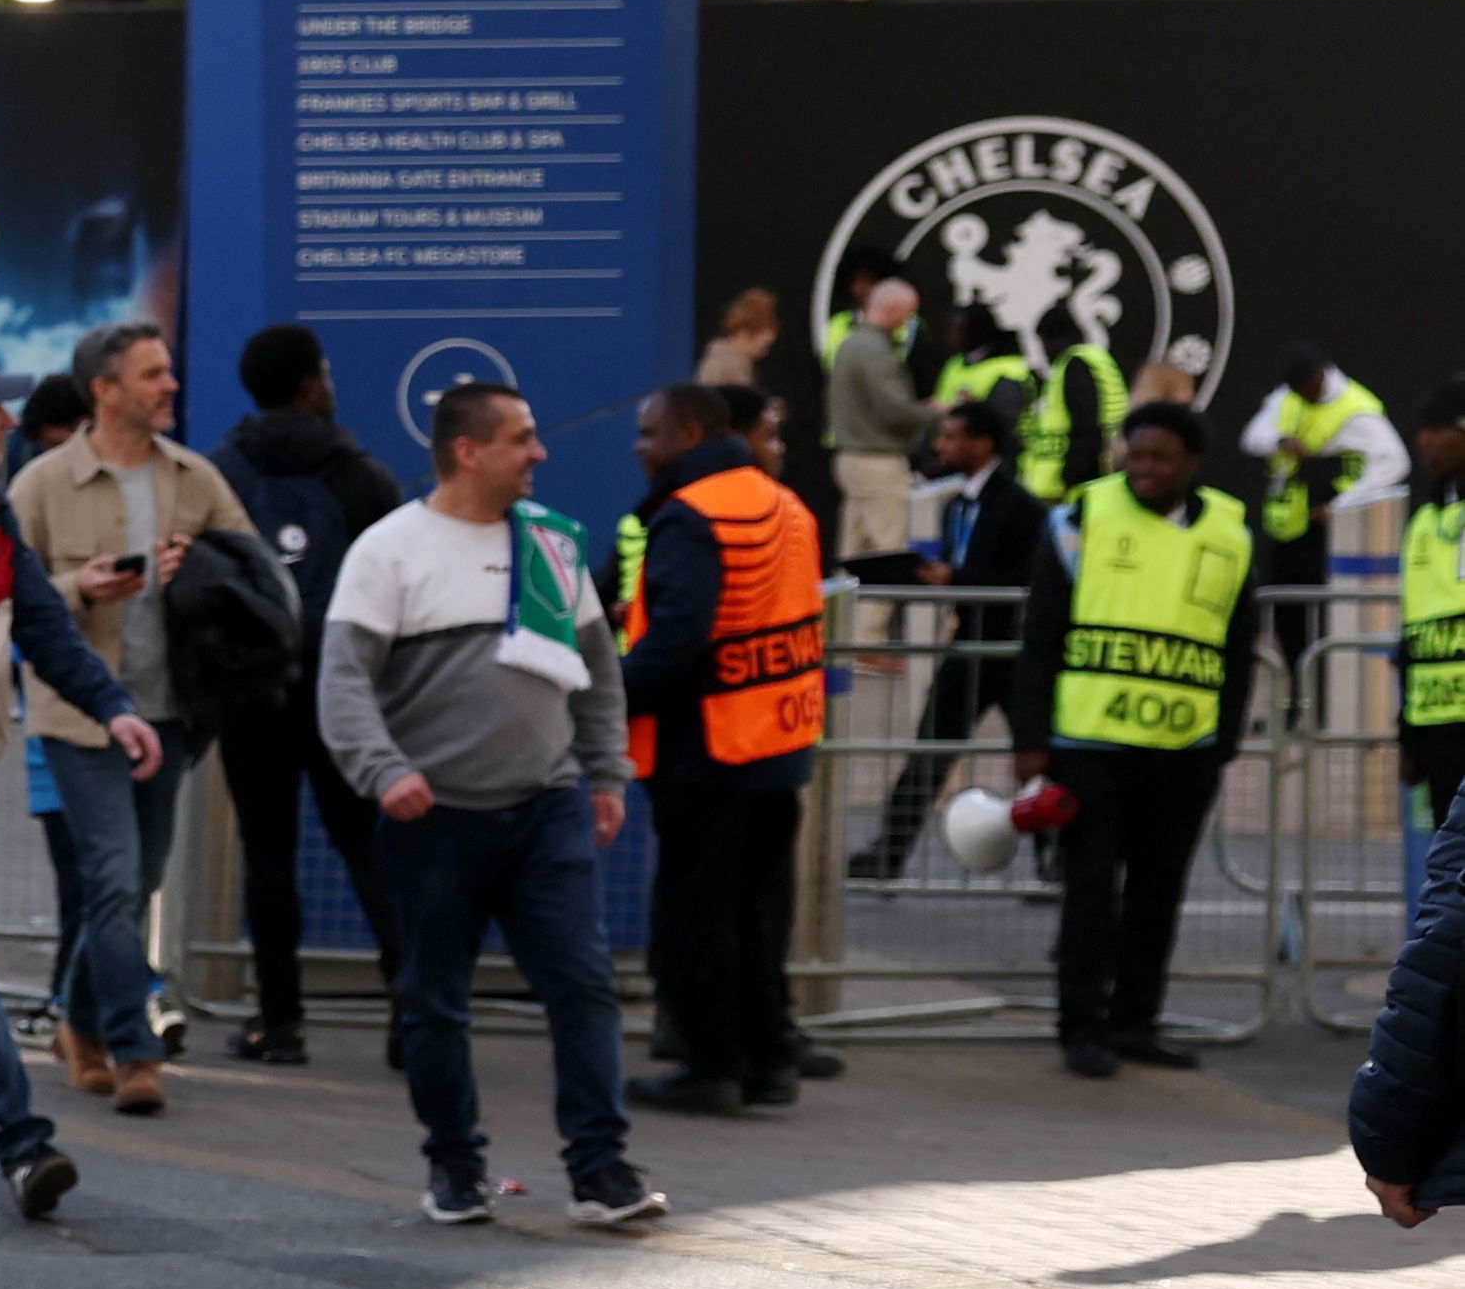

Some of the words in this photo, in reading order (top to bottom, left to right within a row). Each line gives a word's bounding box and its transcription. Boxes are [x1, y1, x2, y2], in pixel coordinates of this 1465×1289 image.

[297, 16, 362, 36] UNDER
[365, 16, 400, 35] THE
[403, 15, 472, 34] BRIDGE
[347, 55, 398, 74] CLUB
[390, 93, 464, 112] SPORTS
[466, 92, 506, 111] BAR
[508, 92, 521, 111] &
[524, 91, 577, 110] GRILL
[296, 132, 382, 151] CHELSEA
[384, 131, 455, 151] HEALTH
[456, 131, 509, 150] CLUB
[510, 131, 524, 149] &
[526, 130, 565, 149] SPA
[296, 170, 394, 190] BRITANNIA
[397, 169, 444, 189] GATE
[447, 168, 545, 188] ENTRANCE
[888, 133, 1156, 222] CHELSEA
[297, 209, 379, 229] STADIUM
[381, 209, 443, 228] TOURS
[445, 208, 459, 227] &
[461, 207, 544, 227] MUSEUM
[296, 247, 381, 267] CHELSEA
[383, 247, 410, 266] FC
[412, 245, 526, 266] MEGASTORE
[1104, 690, 1196, 733] 400
